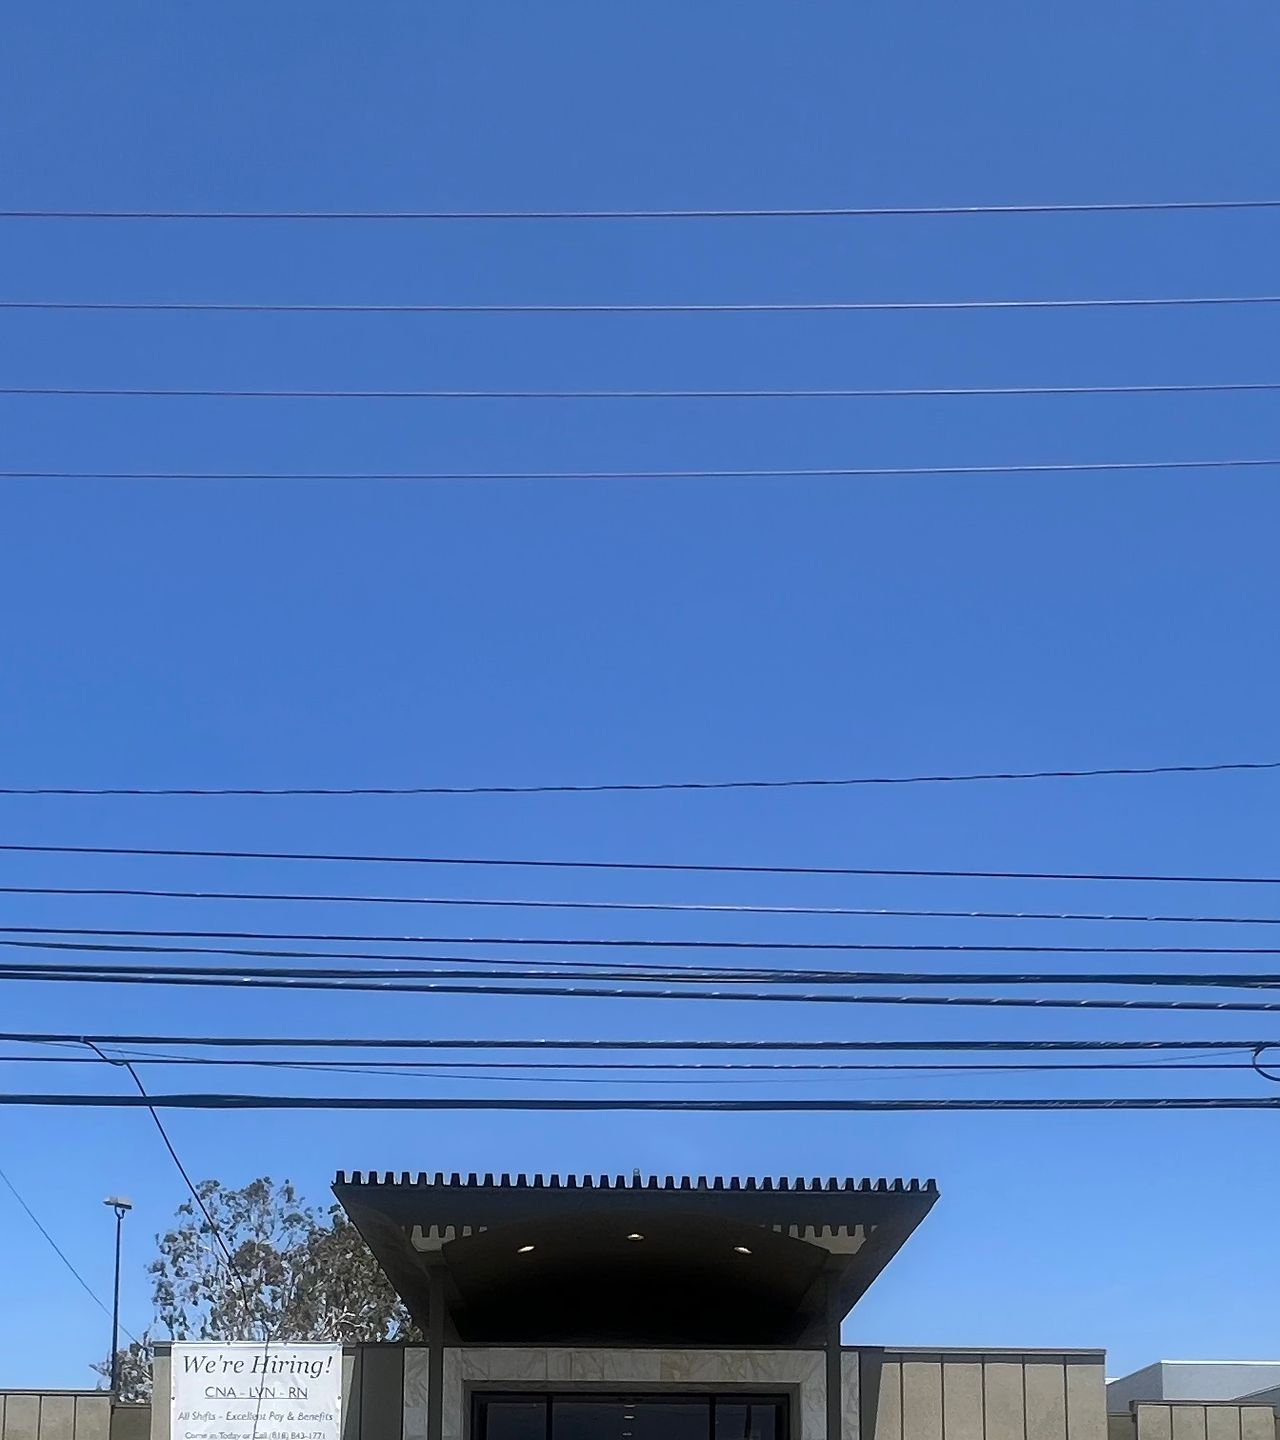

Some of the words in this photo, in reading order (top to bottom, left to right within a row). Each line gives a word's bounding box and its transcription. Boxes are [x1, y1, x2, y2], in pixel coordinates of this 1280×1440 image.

[183, 1355, 245, 1374] We're
[250, 1354, 333, 1379] Hiring!
[205, 1387, 236, 1398] CNA
[249, 1387, 275, 1398] LVN
[288, 1387, 308, 1398] RN
[177, 1411, 190, 1421] All
[192, 1411, 216, 1422] Shifts
[269, 1411, 284, 1422] Pay
[287, 1411, 295, 1421] &
[297, 1411, 333, 1422] Benefits
[219, 1431, 241, 1440] Today
